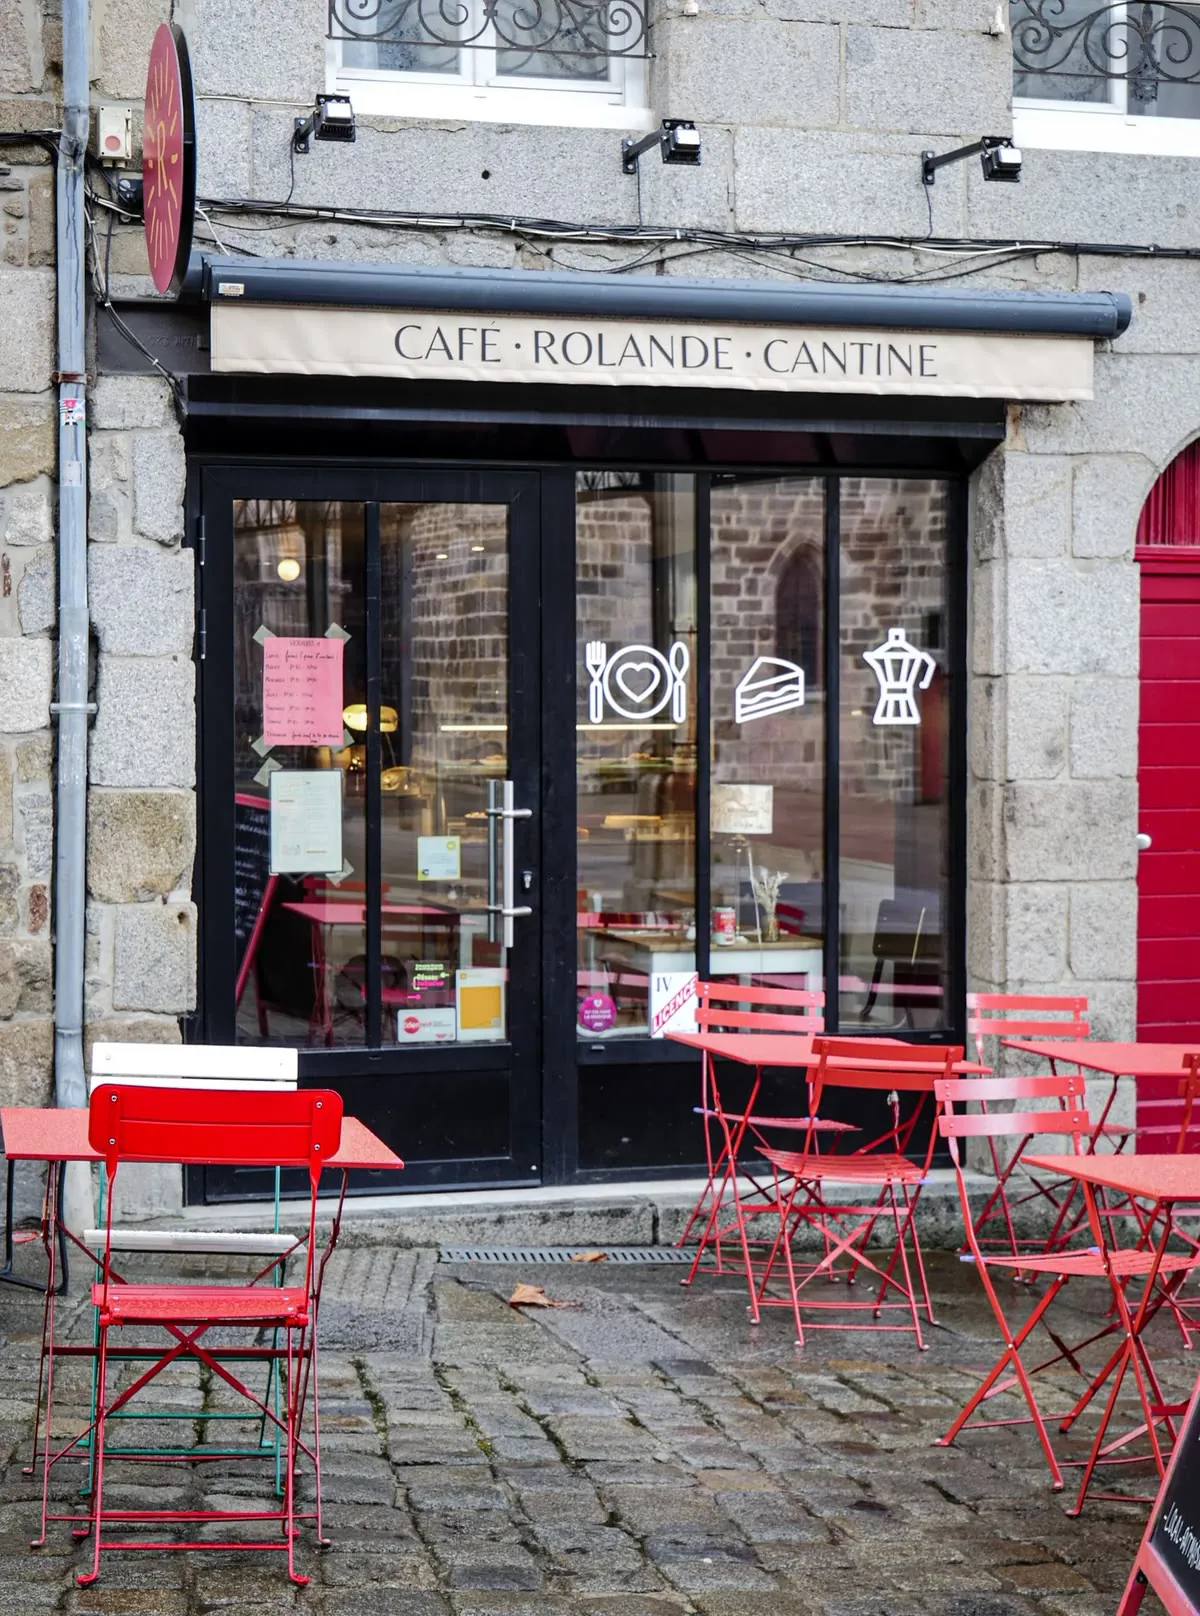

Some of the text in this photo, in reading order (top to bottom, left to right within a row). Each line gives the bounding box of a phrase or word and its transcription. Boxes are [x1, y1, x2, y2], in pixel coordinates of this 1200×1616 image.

[156, 120, 168, 197] R
[394, 320, 938, 377] CAFÉ ROLANDE CANTINE
[653, 976, 697, 1033] LICENCE
[656, 976, 672, 992] IV
